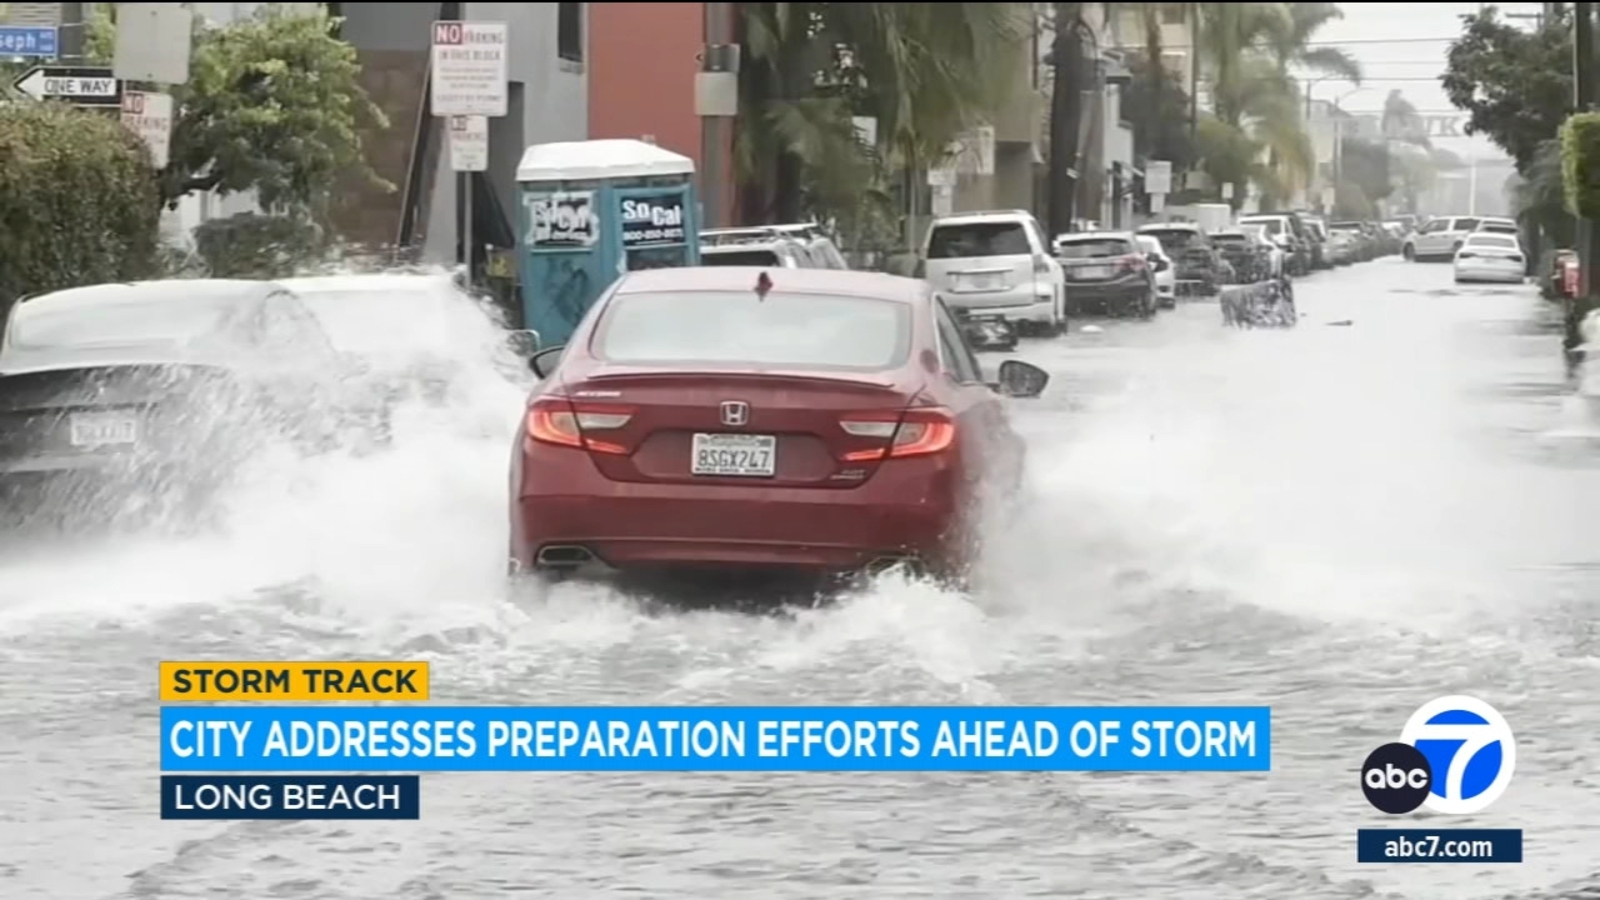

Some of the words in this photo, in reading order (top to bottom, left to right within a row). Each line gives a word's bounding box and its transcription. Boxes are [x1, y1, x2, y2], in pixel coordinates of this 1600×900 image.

[436, 24, 461, 43] NO
[45, 79, 75, 93] ONE
[80, 79, 112, 93] WAY
[699, 448, 770, 469] 8SGX247
